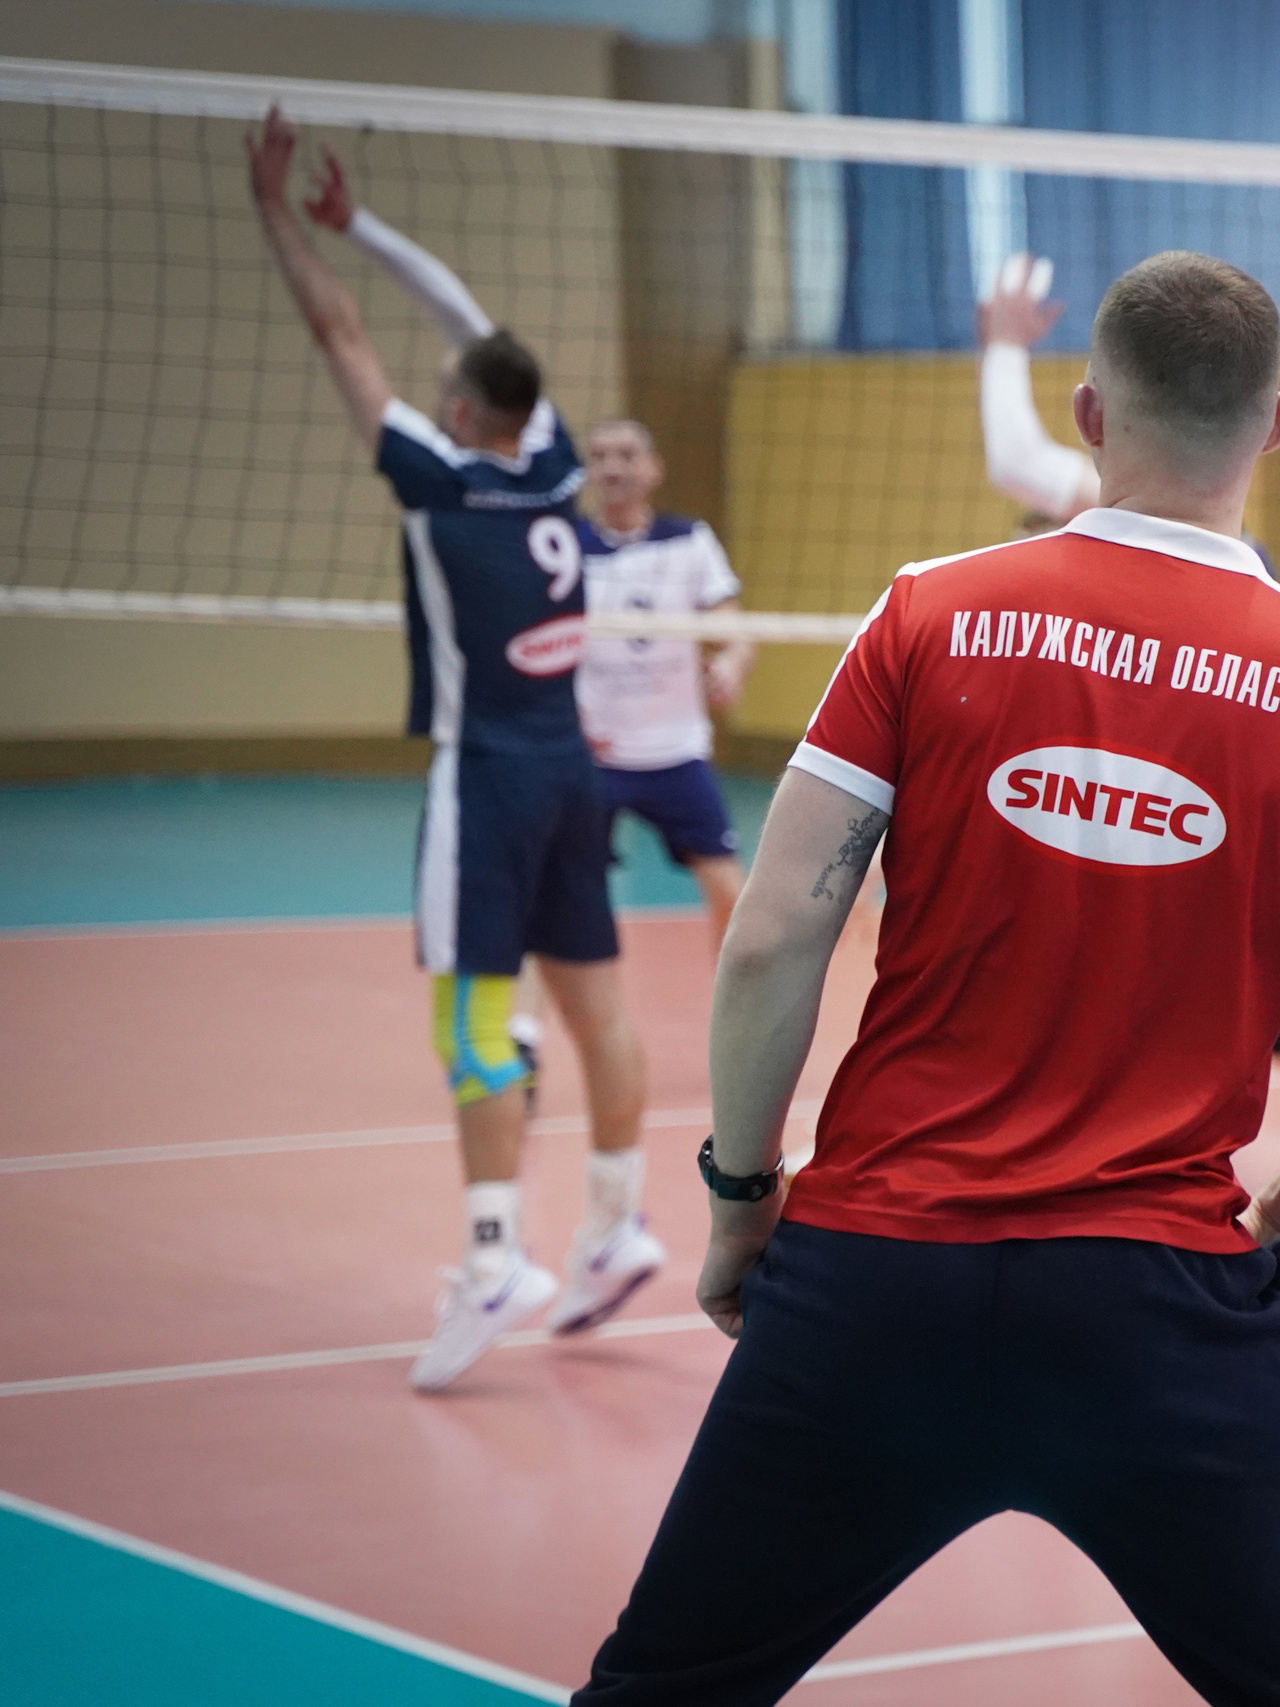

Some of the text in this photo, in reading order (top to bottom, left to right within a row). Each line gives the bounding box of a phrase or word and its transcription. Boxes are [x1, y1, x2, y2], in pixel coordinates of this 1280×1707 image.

[526, 515, 581, 602] 9
[949, 611, 1161, 685] КАЛУЖСКАЯ
[1006, 768, 1210, 845] SINTEC
